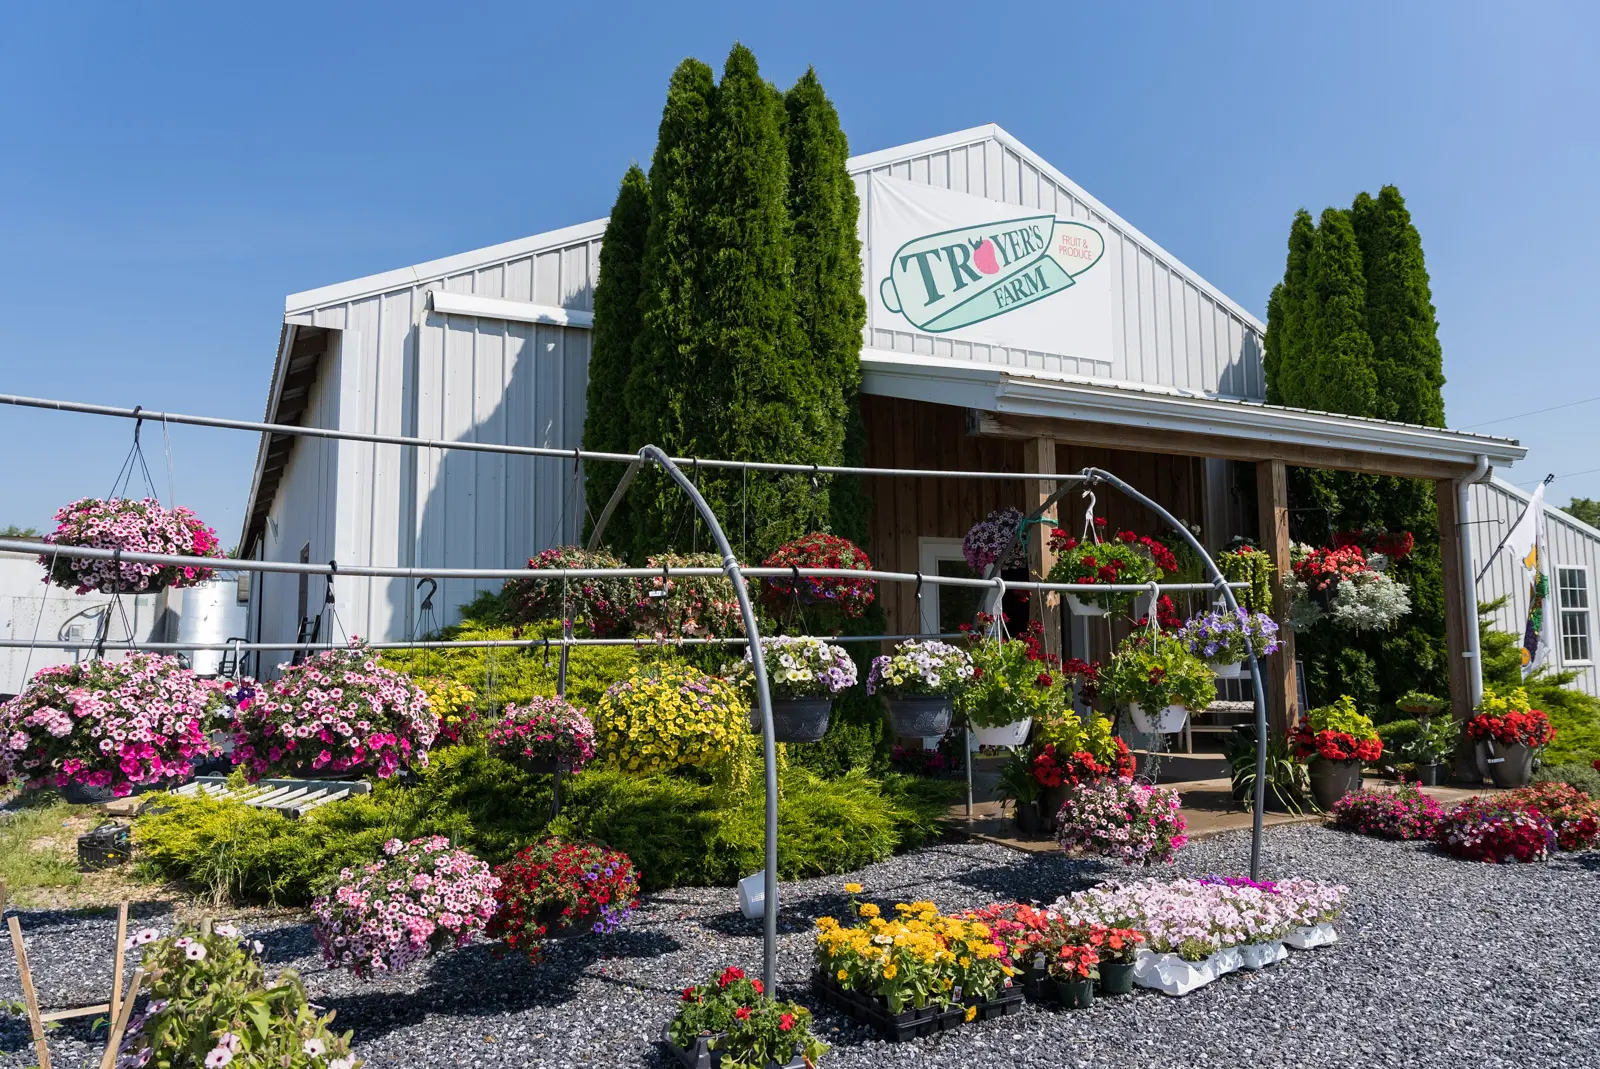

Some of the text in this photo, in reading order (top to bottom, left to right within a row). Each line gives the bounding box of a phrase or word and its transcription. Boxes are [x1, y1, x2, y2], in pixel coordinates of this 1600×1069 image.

[1062, 235, 1088, 249] FRUIT &
[1059, 245, 1092, 260] PRODUCE
[993, 265, 1050, 309] FARM
